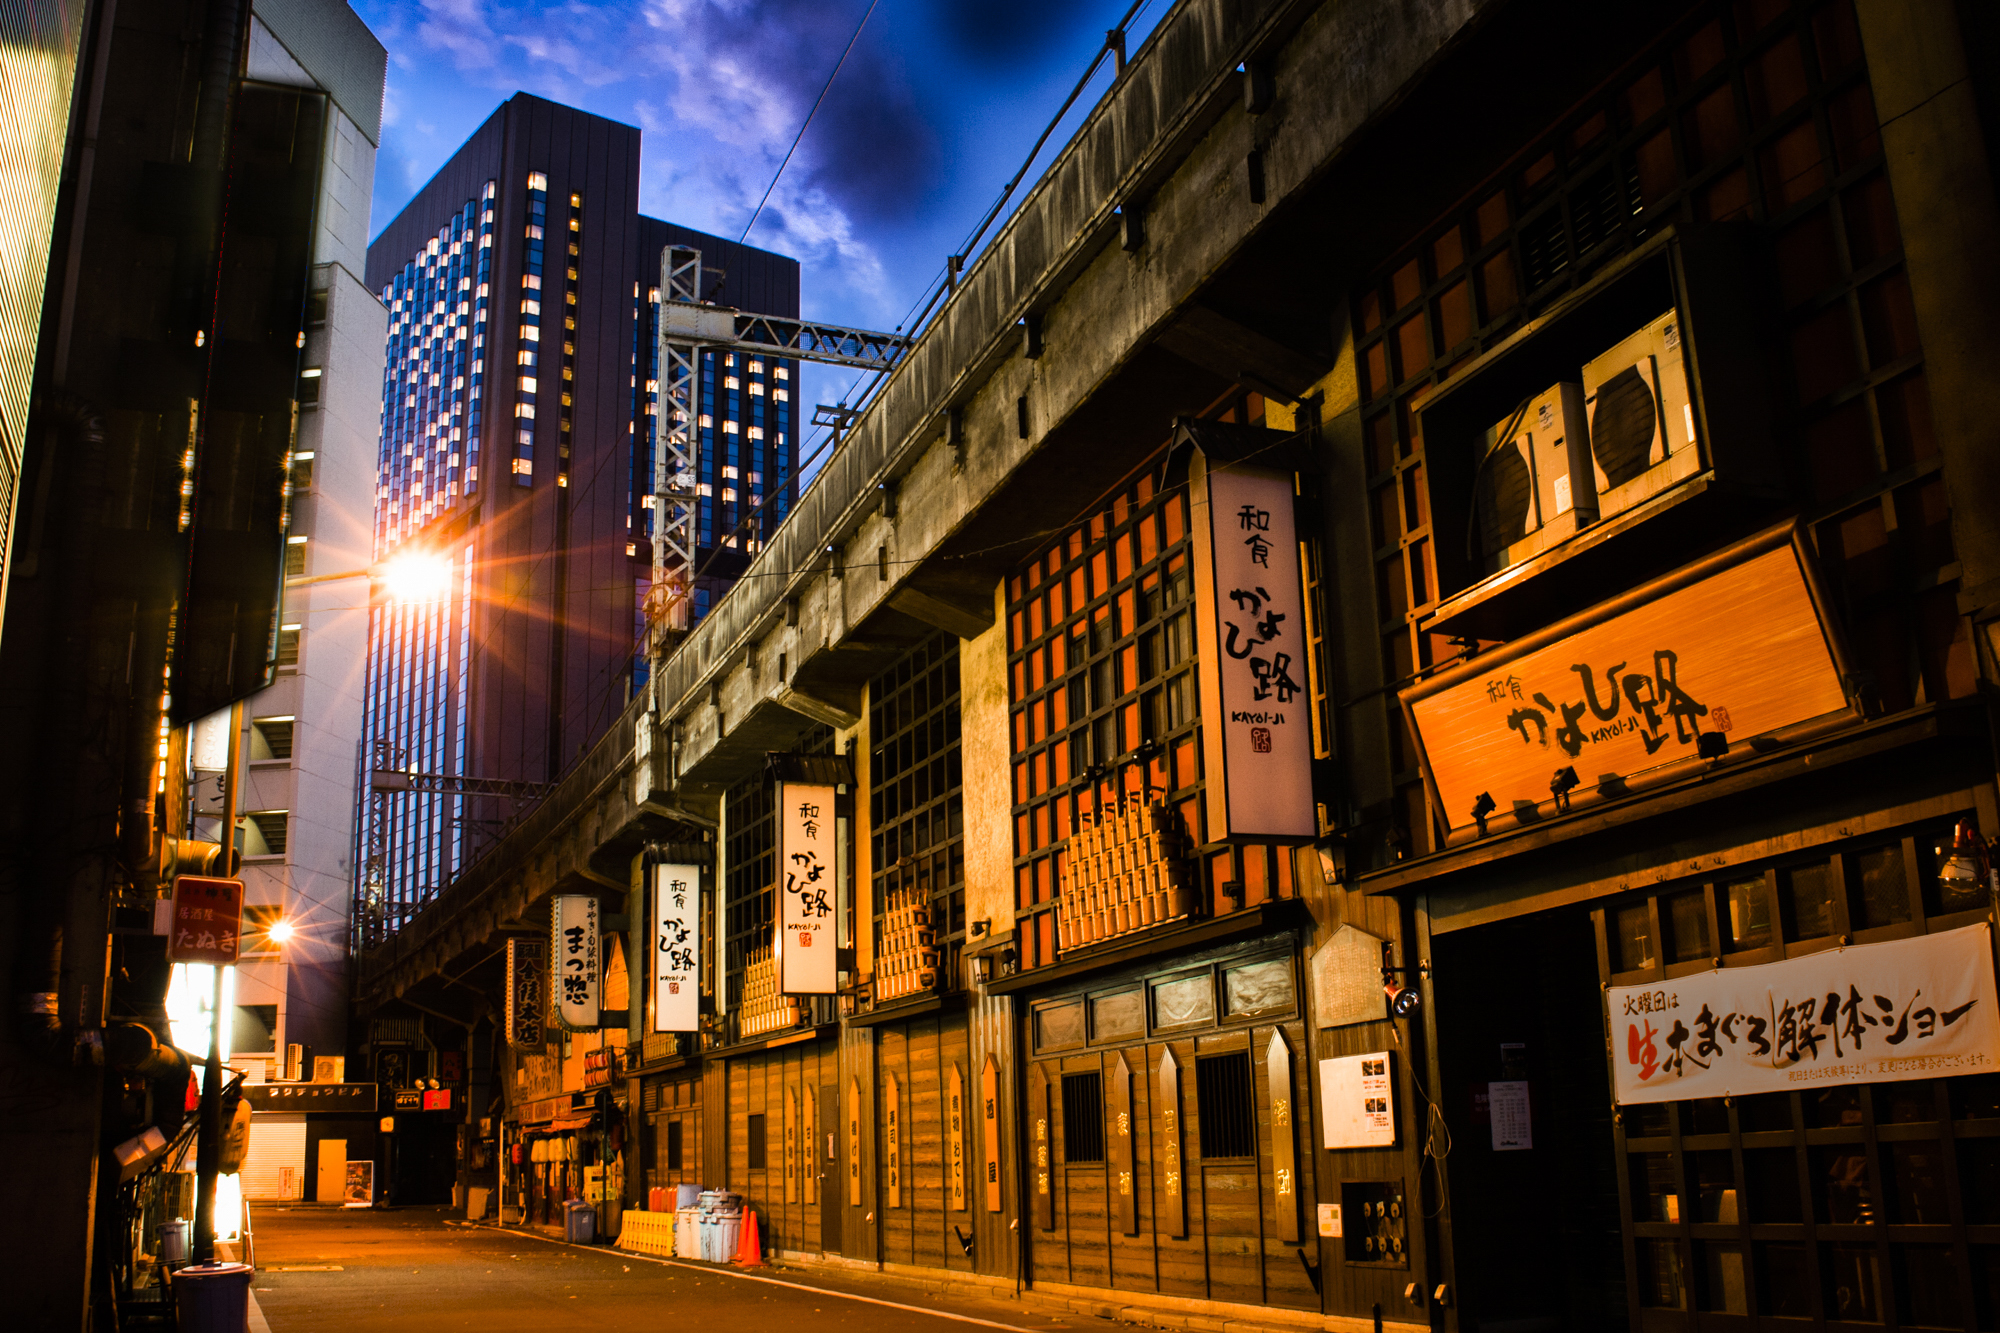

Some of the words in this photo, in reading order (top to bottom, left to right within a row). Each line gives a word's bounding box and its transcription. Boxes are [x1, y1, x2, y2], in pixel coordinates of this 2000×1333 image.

[1237, 505, 1274, 569] 和食
[1225, 586, 1301, 703] かよひ路
[1486, 673, 1522, 703] 和食
[1507, 649, 1709, 758] かよひ路
[1231, 711, 1285, 725] KAYOI-JI
[1591, 716, 1639, 745] KAYOI-JI
[798, 802, 819, 841] 和食
[670, 879, 687, 910] 和食
[787, 851, 832, 919] かよひ路
[178, 907, 214, 921] 居酒屋
[788, 923, 821, 931] KAYOI-JI
[176, 927, 235, 952] たぬき
[659, 918, 696, 972] かよひ路
[564, 926, 589, 1006] まつ惣
[1623, 990, 1679, 1016] 火曜日は
[269, 1087, 363, 1097] ラクチョウビル
[954, 1141, 962, 1198] おでん
